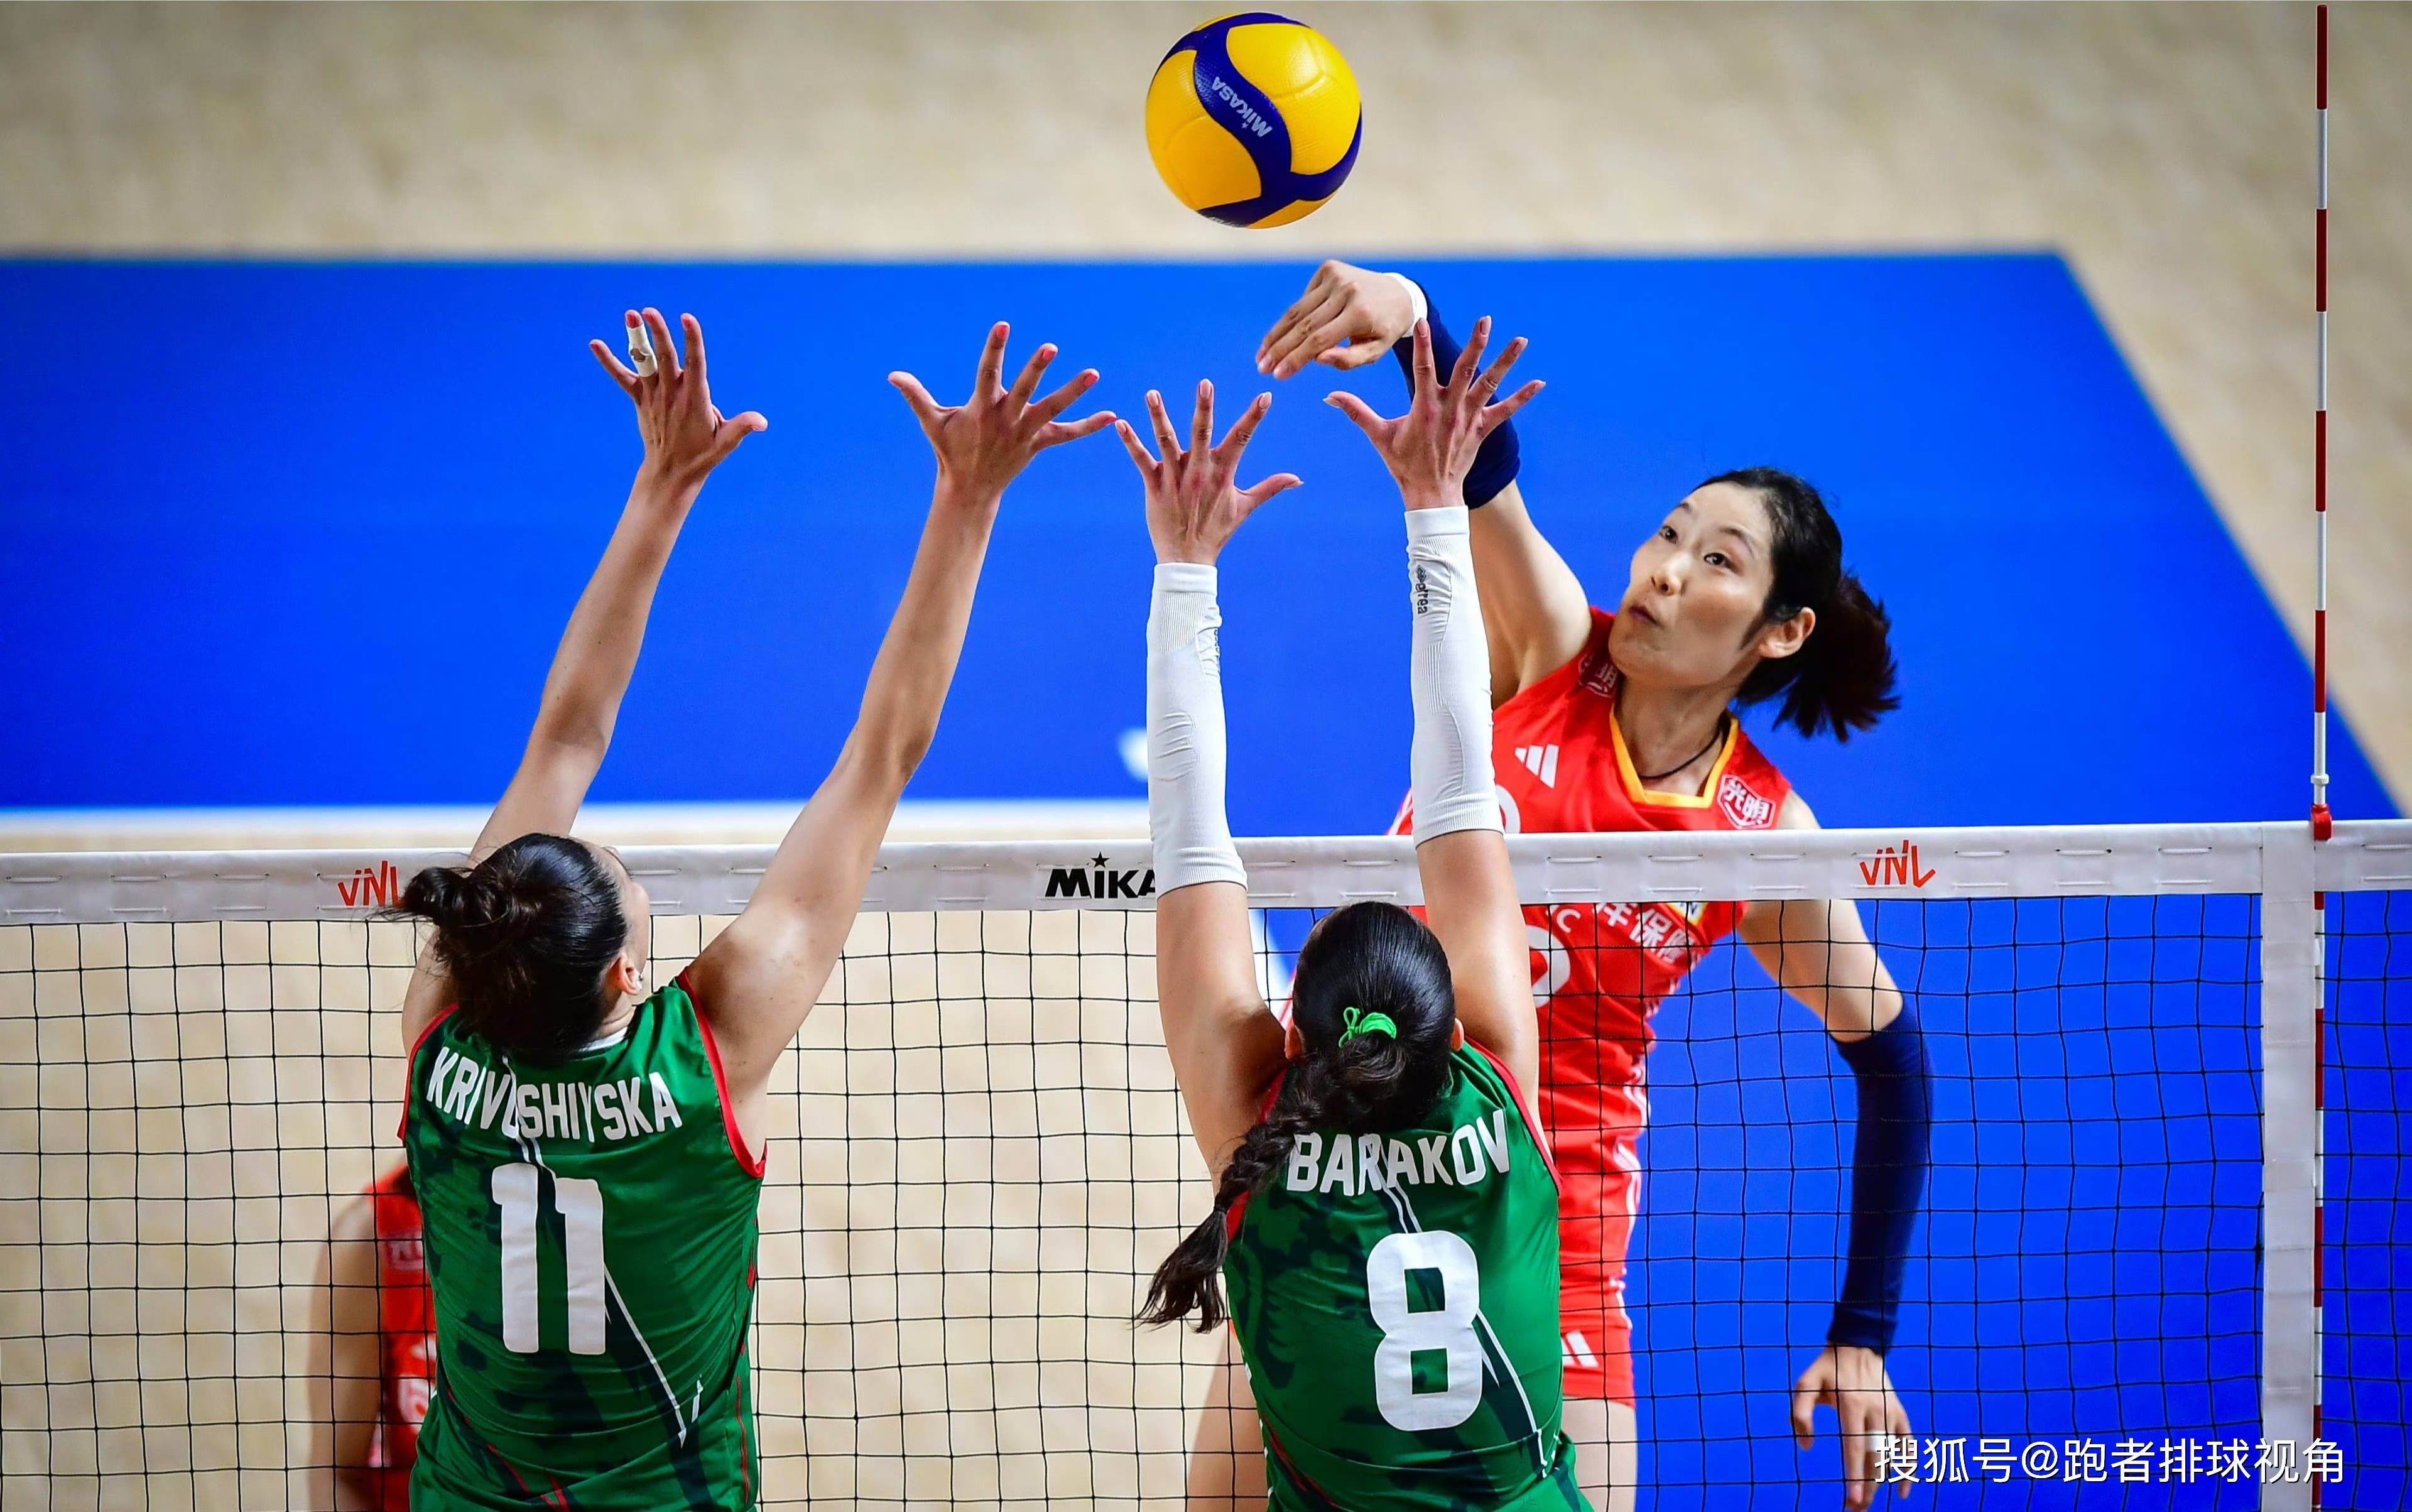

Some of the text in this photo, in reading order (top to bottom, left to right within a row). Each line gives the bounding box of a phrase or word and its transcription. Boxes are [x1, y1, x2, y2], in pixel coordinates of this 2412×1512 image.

[1859, 839, 1936, 888] VNL
[426, 1046, 683, 1143] KRIVOSHIYSKA
[491, 1162, 606, 1354] 11
[1367, 1229, 1482, 1432] 8
